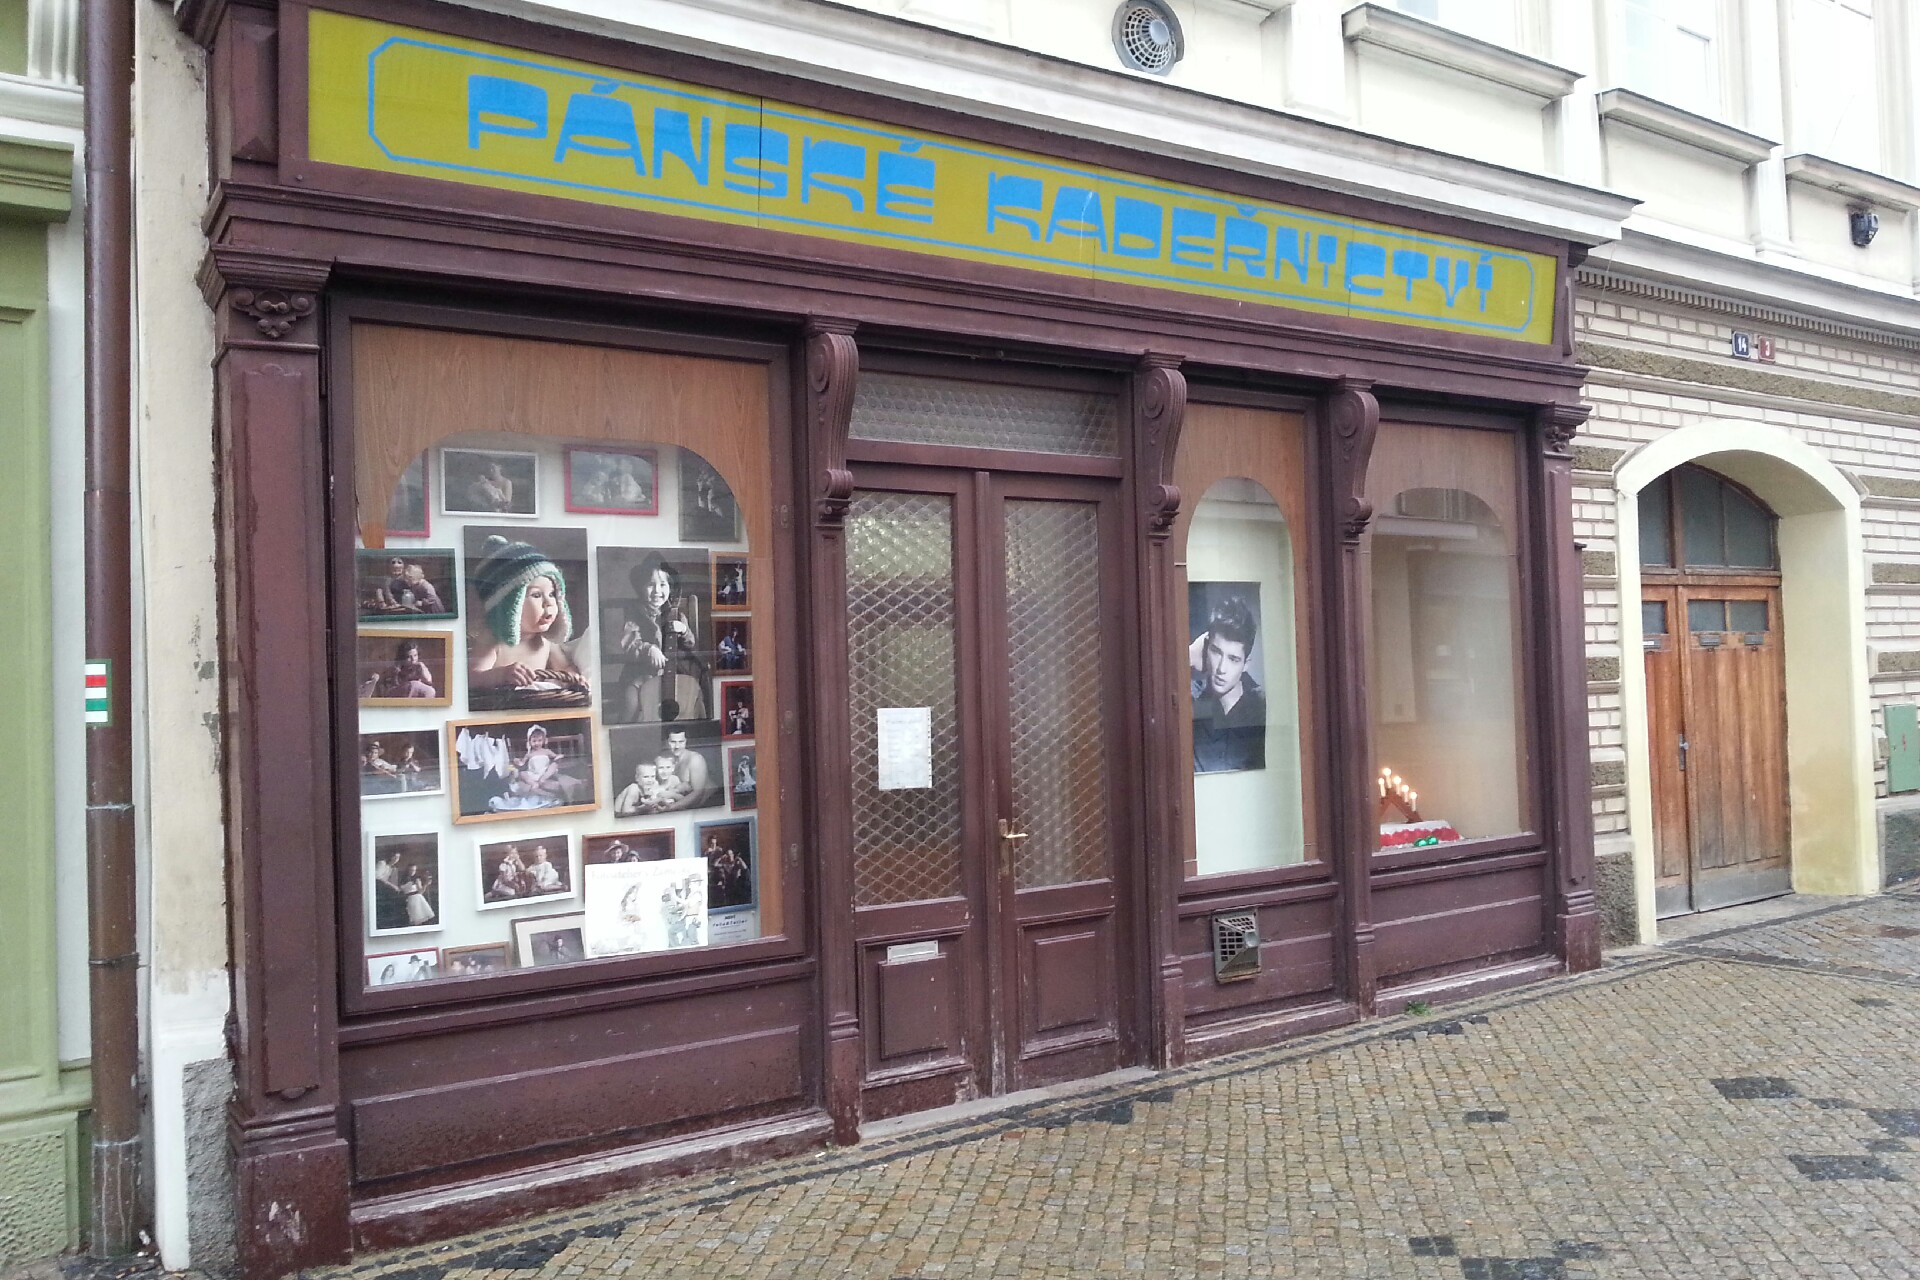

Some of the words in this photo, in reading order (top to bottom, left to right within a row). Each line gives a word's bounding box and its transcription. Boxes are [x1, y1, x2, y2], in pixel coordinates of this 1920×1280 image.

[468, 75, 936, 224] PÁNSKÉ
[987, 172, 1493, 313] KADEŘNICTVÍ
[1737, 335, 1747, 353] 14
[1765, 341, 1771, 357] 3
